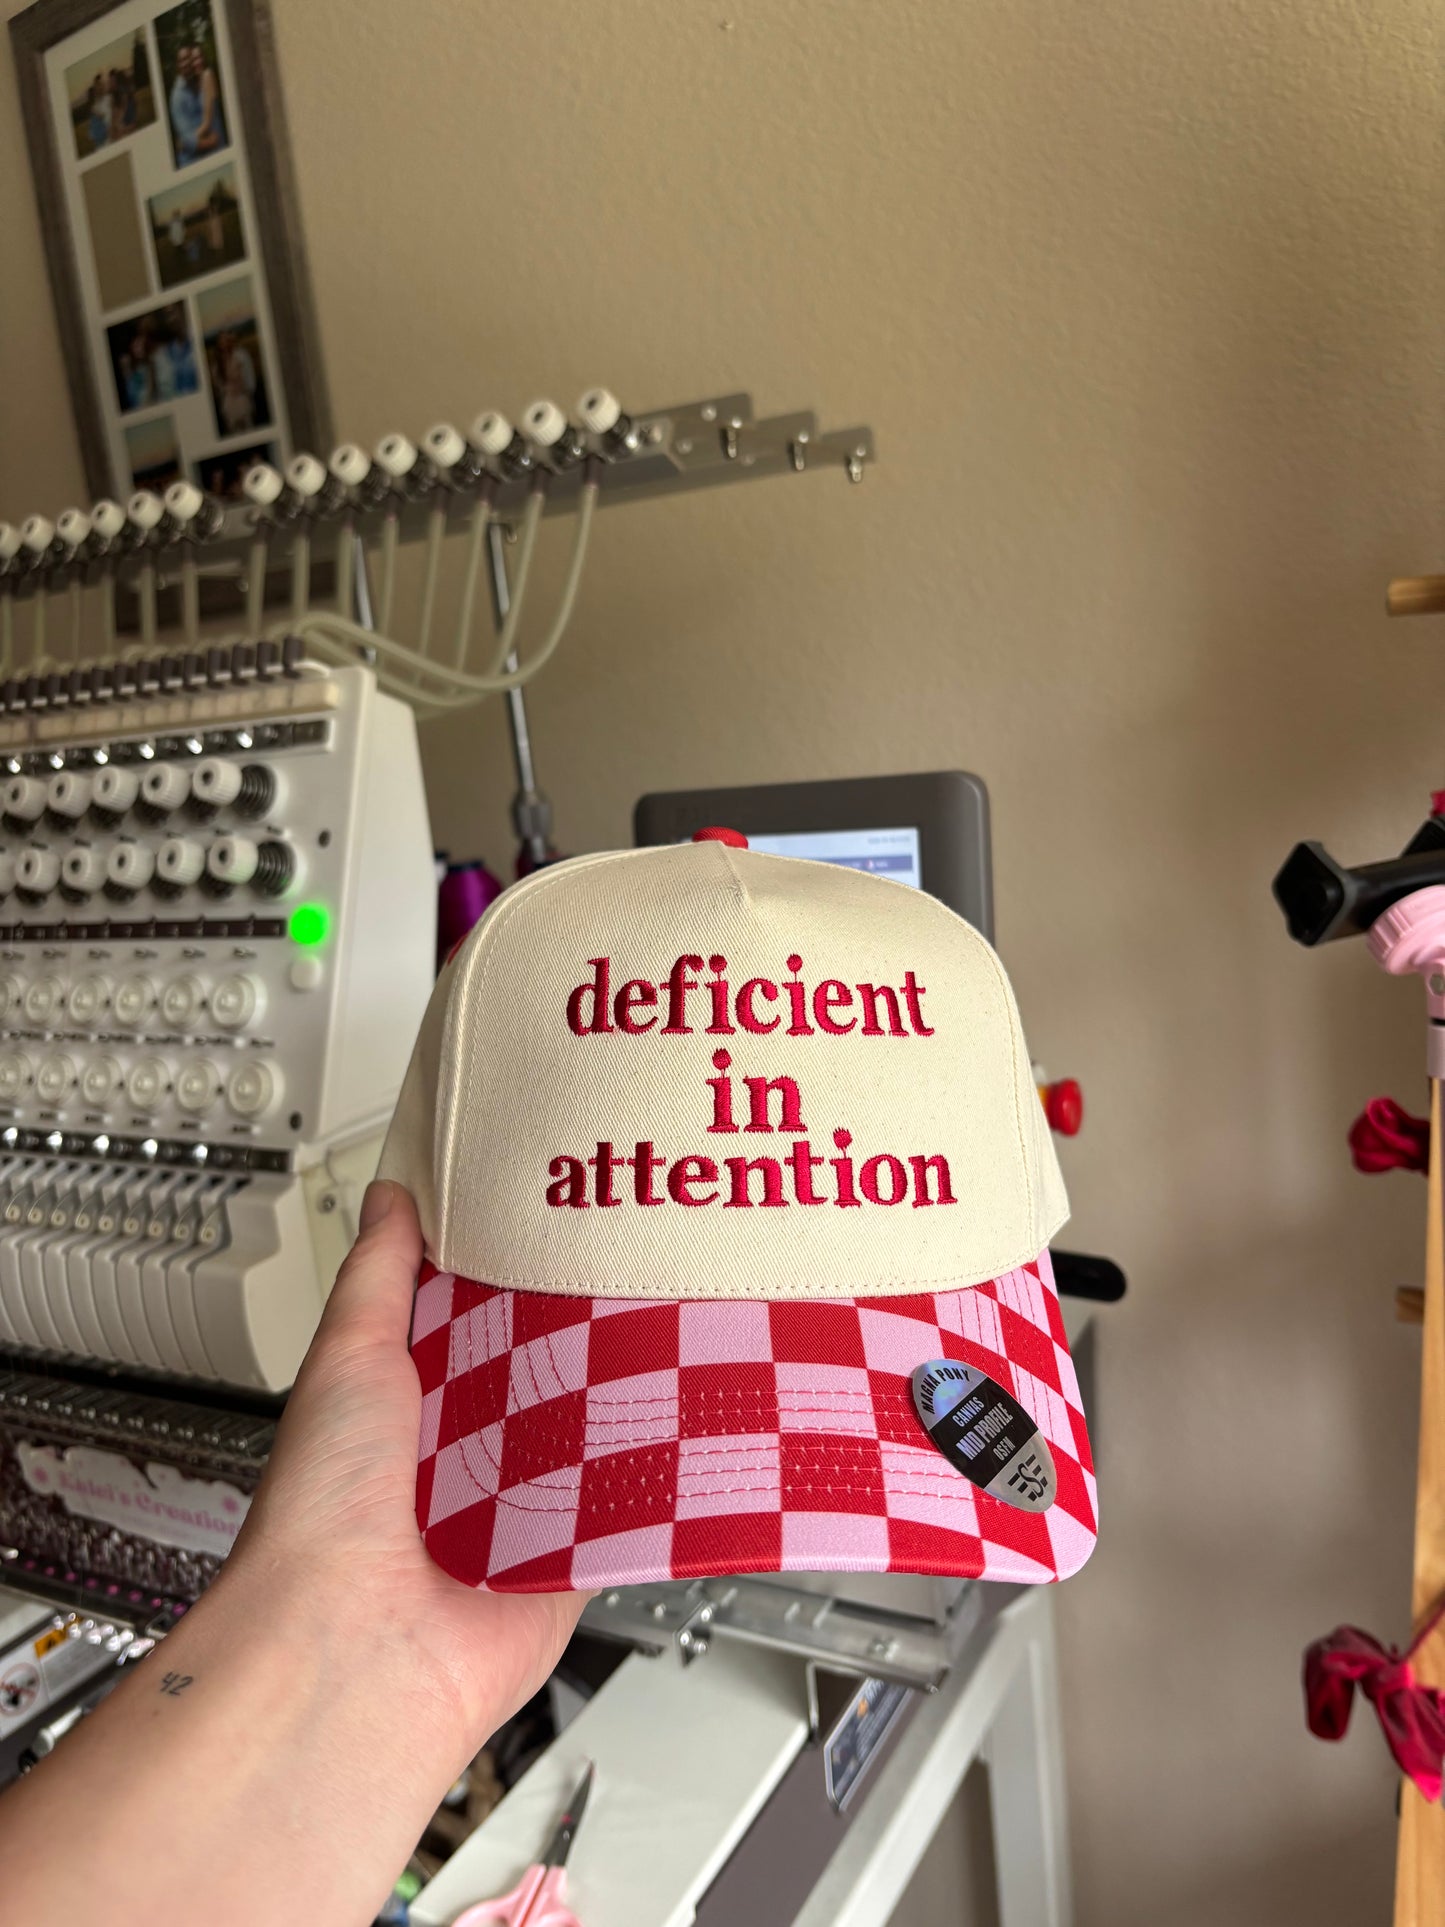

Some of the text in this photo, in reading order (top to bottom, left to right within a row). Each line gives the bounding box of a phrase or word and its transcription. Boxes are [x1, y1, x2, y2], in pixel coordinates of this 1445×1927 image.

[566, 953, 935, 1037] deficient
[706, 1047, 808, 1134] in
[546, 1127, 958, 1209] attention
[920, 1367, 971, 1415] MAGNA PONY
[952, 1396, 985, 1427] CANVAS
[955, 1402, 1014, 1461] MID PROFILE
[992, 1436, 1016, 1461] OSFM
[160, 1671, 193, 1696] 42
